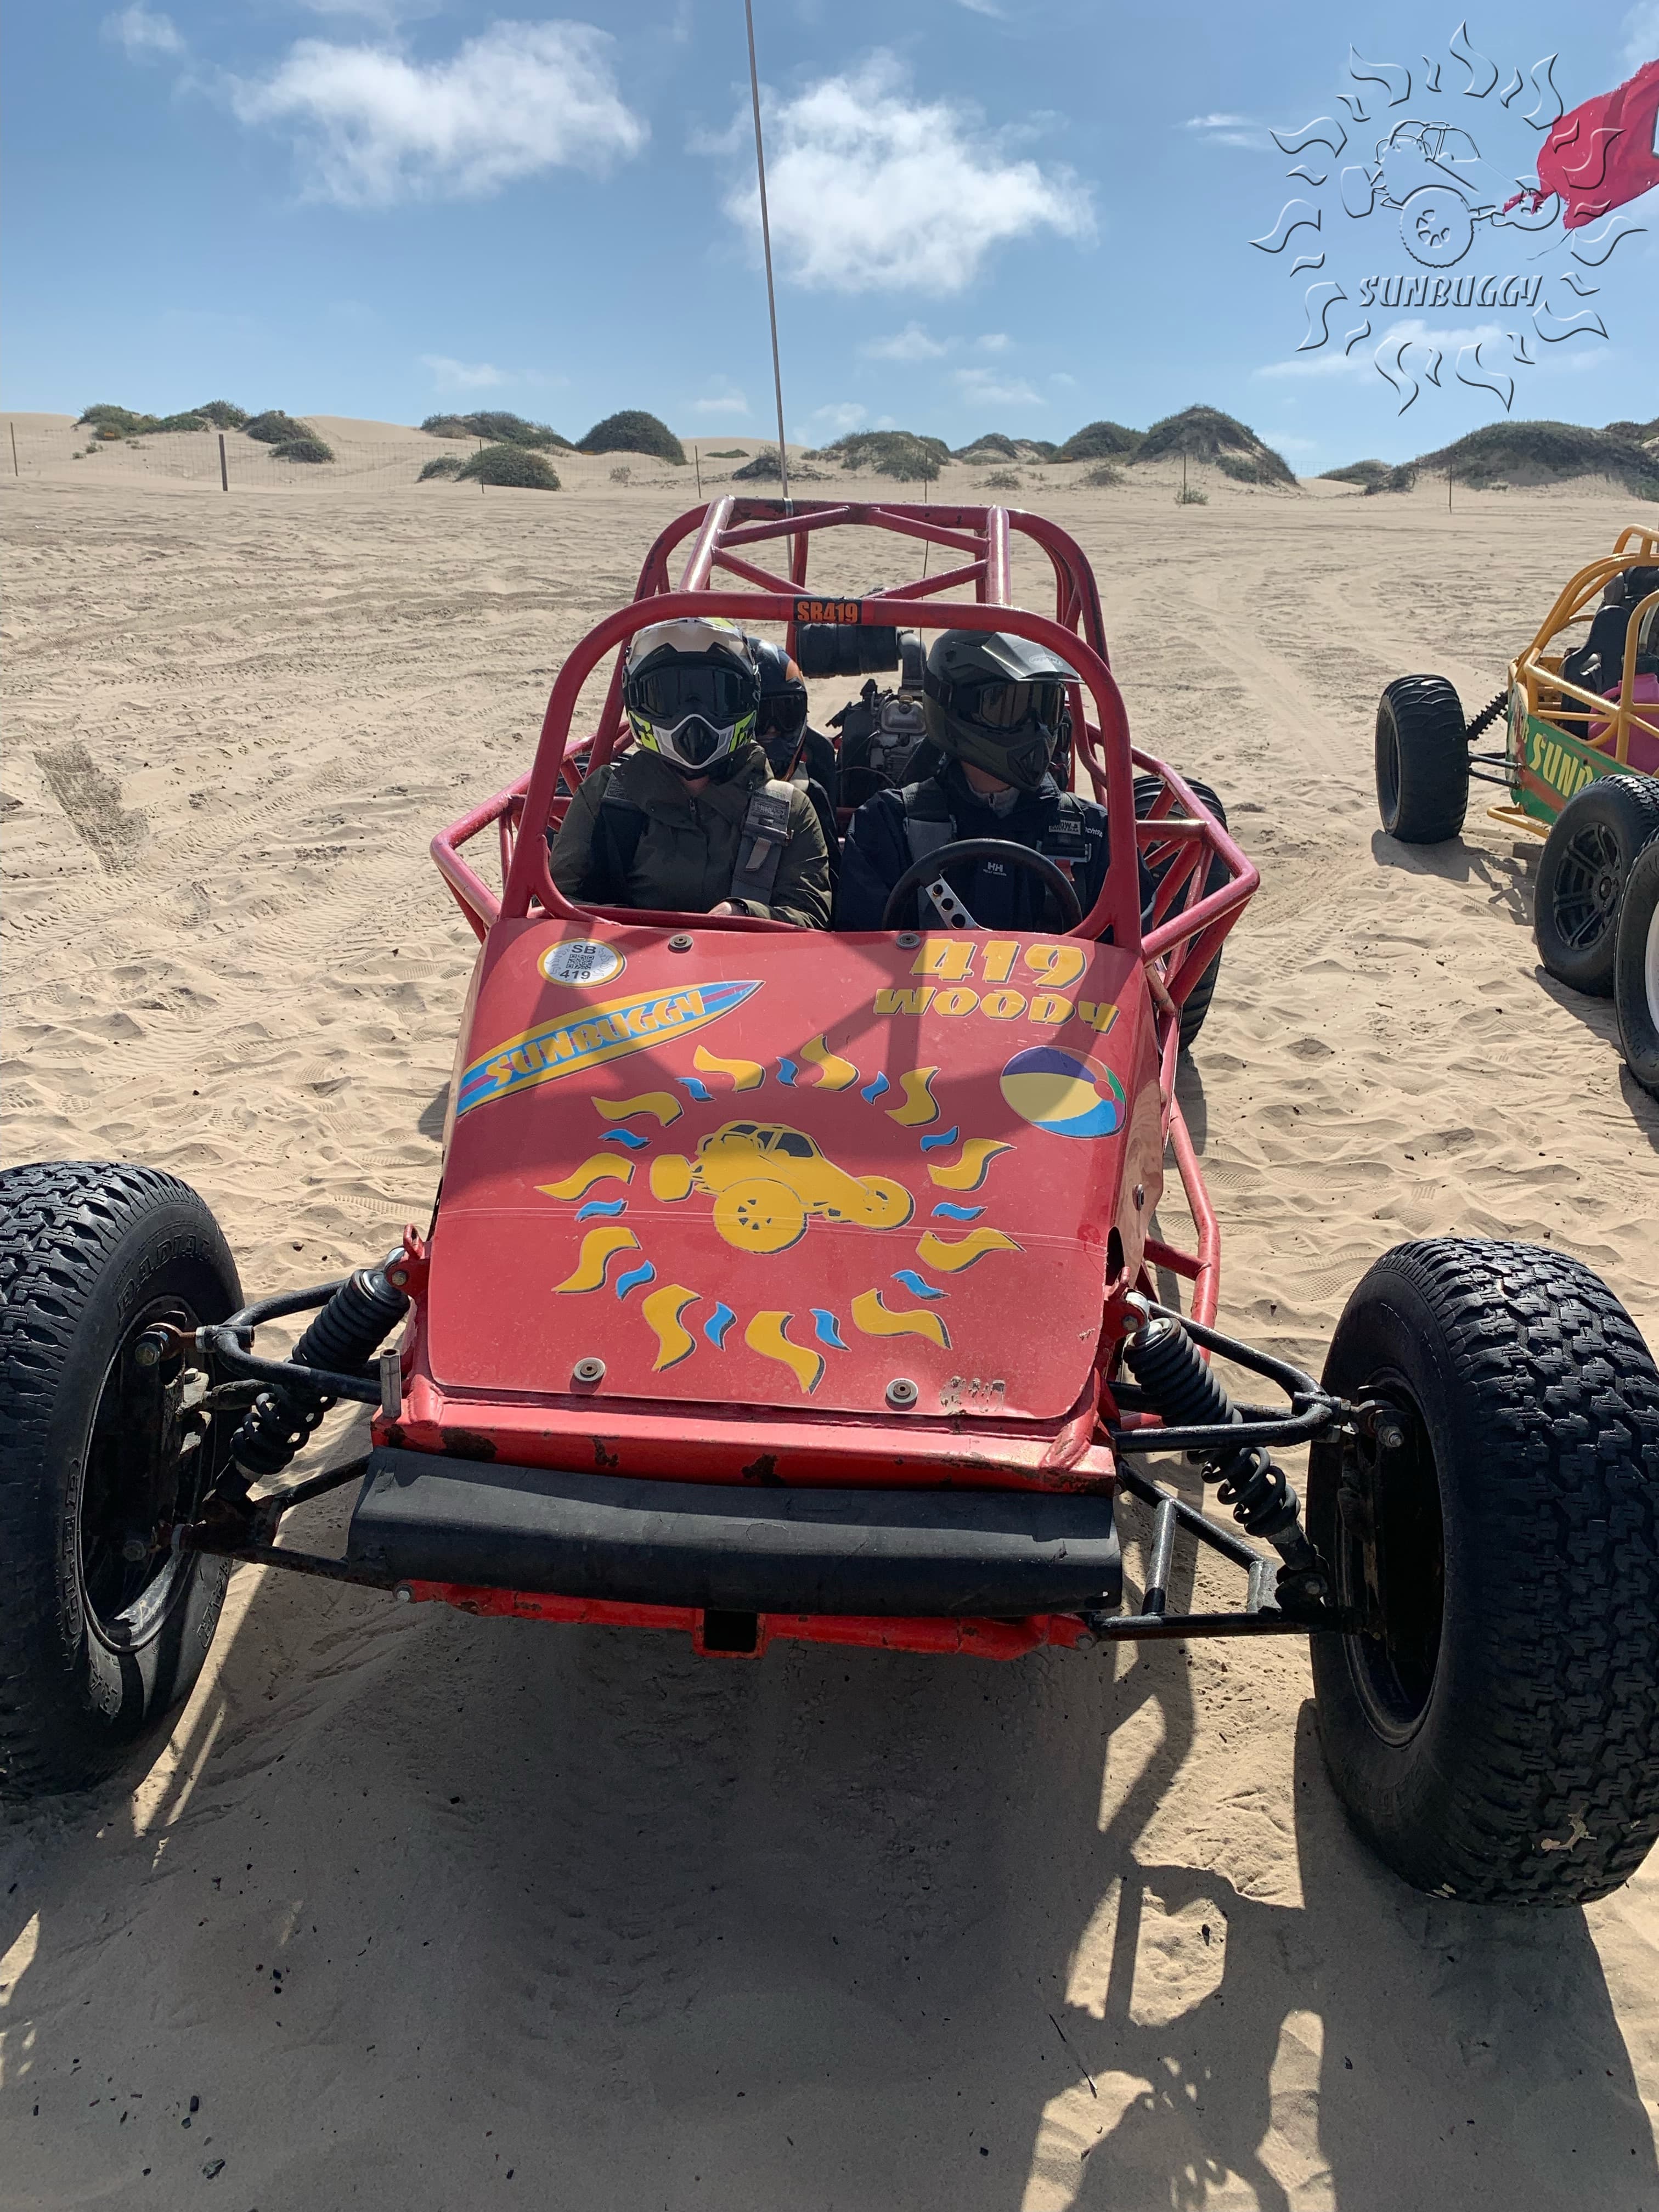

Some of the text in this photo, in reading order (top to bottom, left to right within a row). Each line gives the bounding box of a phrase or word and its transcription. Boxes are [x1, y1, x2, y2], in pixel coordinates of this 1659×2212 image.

[797, 601, 858, 623] SB419
[571, 945, 596, 954] SB
[910, 938, 1087, 990] 419
[560, 969, 591, 979] 419
[873, 986, 1120, 1035] WOODY
[486, 989, 706, 1087] SUNBUGGY
